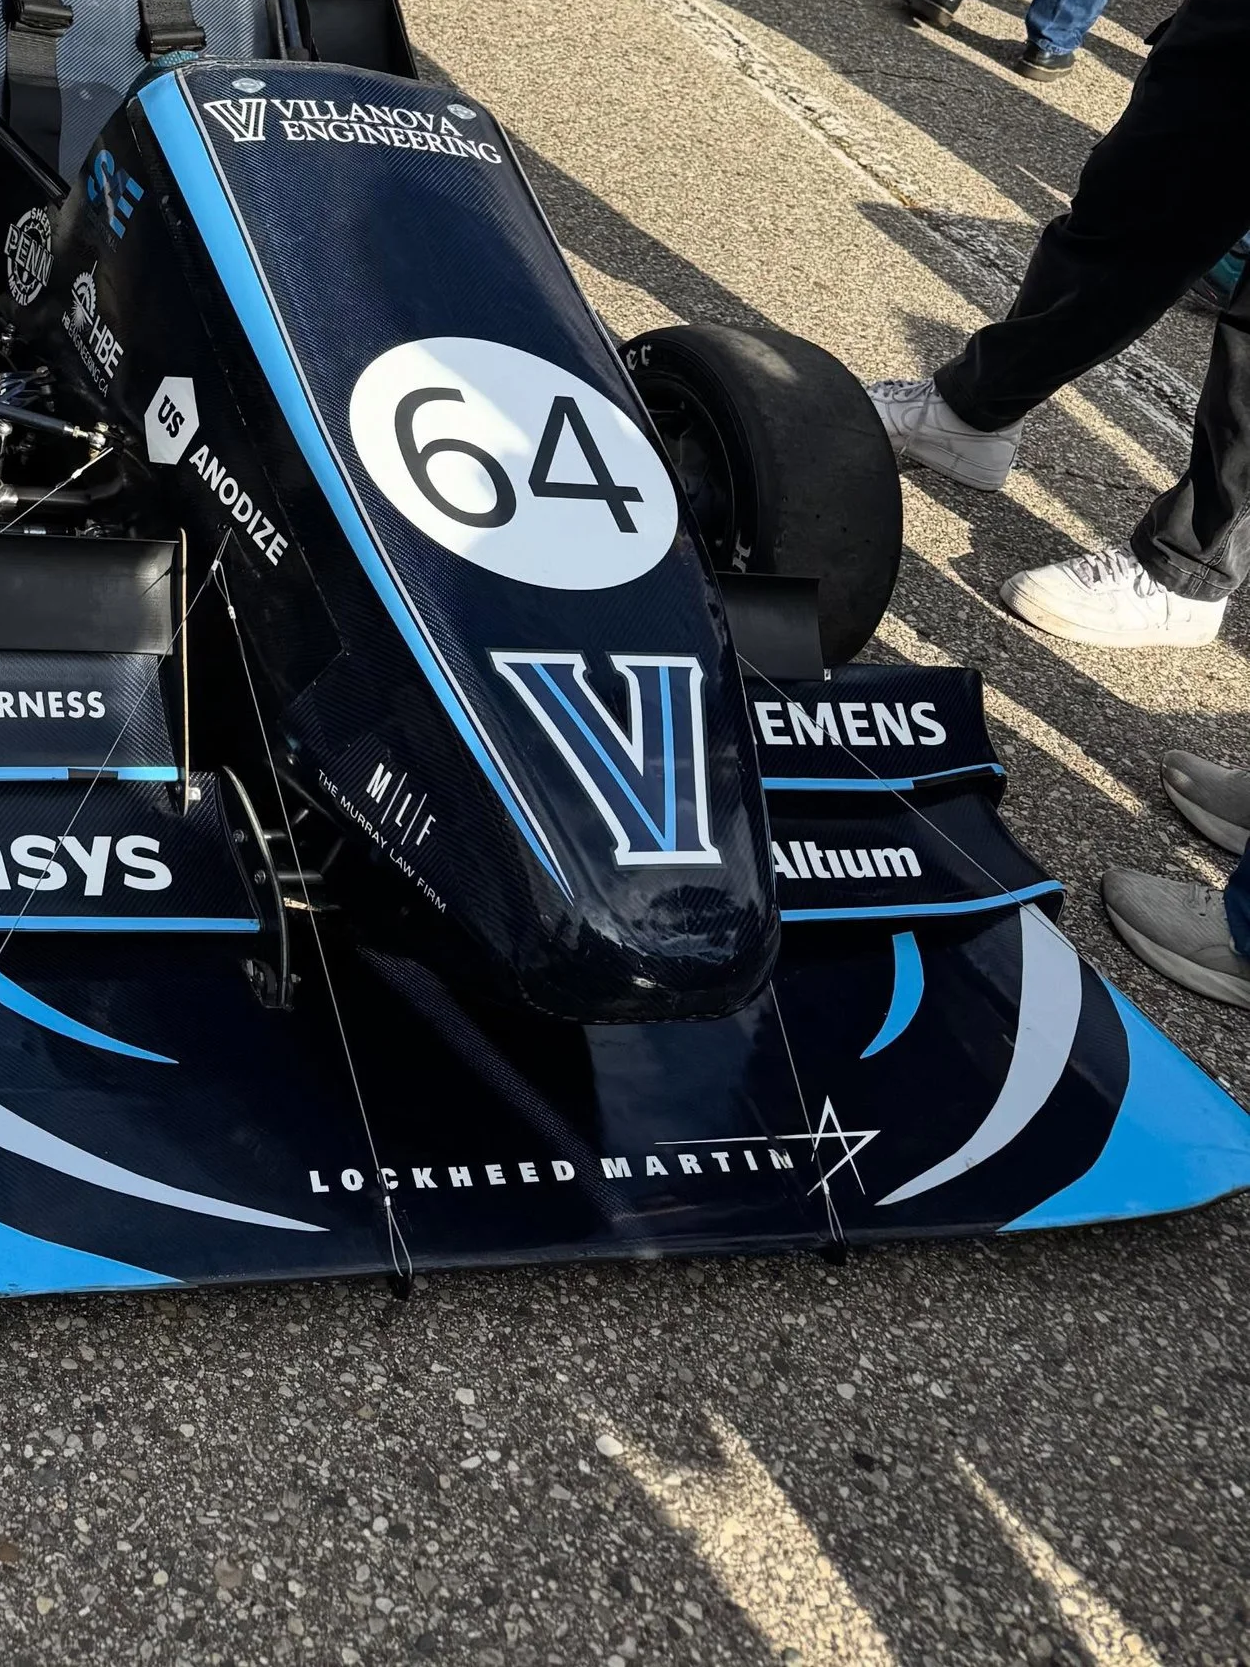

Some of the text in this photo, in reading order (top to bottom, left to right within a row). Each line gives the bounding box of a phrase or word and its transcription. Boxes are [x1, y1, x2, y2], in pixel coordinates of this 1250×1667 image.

[273, 98, 464, 137] VILLANOVA
[279, 119, 503, 165] ENGINEERING
[4, 223, 55, 287] PENN
[8, 274, 30, 307] METAL
[88, 314, 125, 380] HBE
[157, 394, 185, 439] US
[394, 386, 645, 534] 64
[188, 444, 289, 567] ANODIZE
[752, 701, 948, 747] EMENS
[489, 650, 723, 867] V
[318, 769, 447, 914] THE MURRAY LAW FIRM
[308, 1147, 795, 1194] LOCKHEED MARTIN
